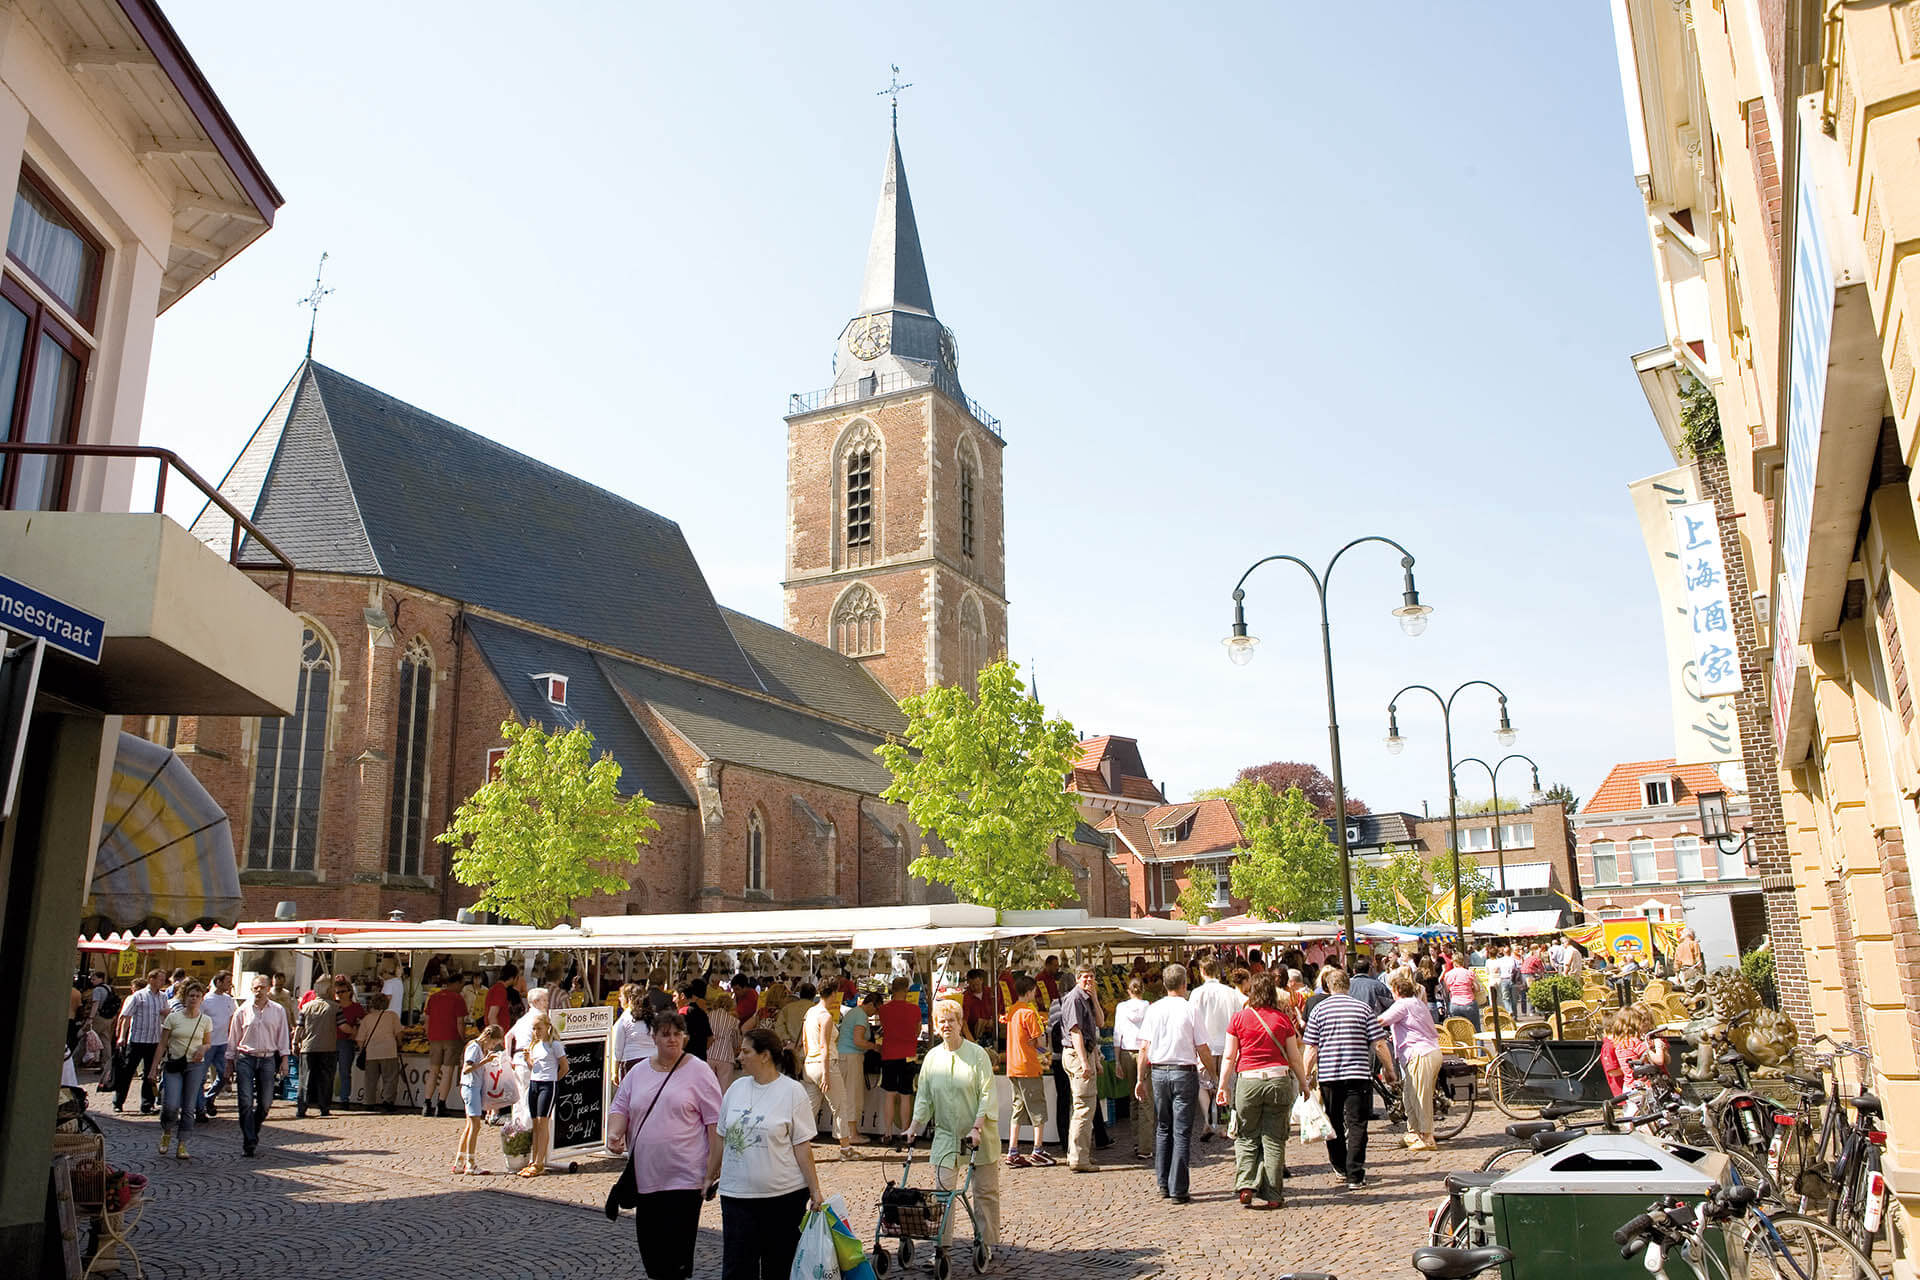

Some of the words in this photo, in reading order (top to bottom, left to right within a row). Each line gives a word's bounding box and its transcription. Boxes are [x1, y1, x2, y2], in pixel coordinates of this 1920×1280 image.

[1684, 514, 1735, 684] 上海酒家
[566, 1013, 588, 1023] Koos
[590, 1011, 609, 1021] Prins
